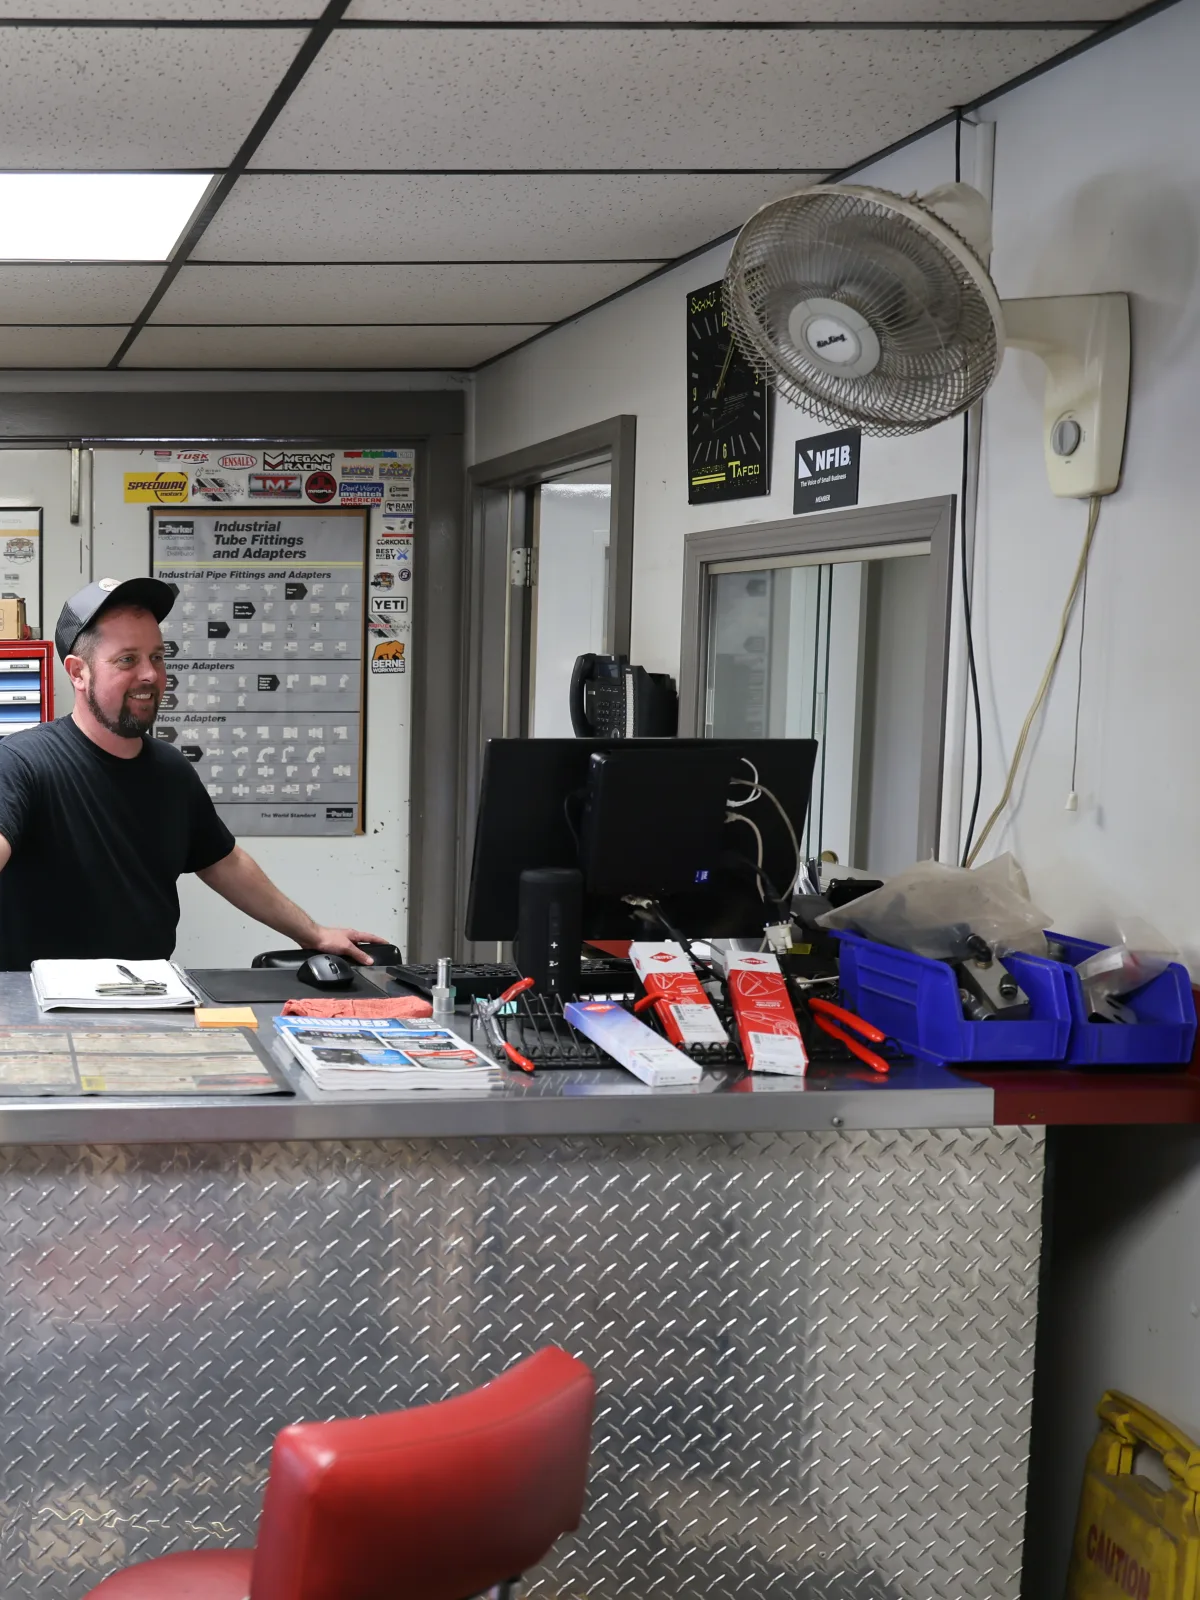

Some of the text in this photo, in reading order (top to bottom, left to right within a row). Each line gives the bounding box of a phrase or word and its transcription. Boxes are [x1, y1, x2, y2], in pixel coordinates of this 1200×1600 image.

[692, 387, 697, 401] 9
[722, 443, 728, 459] 6
[221, 457, 254, 467] JENSALES
[284, 453, 332, 463] MEGAN
[815, 444, 851, 471] NFIB
[284, 463, 332, 471] RACING
[807, 479, 817, 487] Voice
[831, 473, 847, 482] Business
[127, 481, 187, 491] SPEEDWAY
[815, 493, 831, 503] MEMBER
[165, 525, 194, 534] Parker
[214, 521, 282, 532] Industrial
[214, 534, 304, 548] Tube Fittings
[212, 548, 307, 561] and Adapters
[158, 570, 332, 581] Industrial Pipe Fittings and Adapters
[374, 600, 405, 610] YETI
[165, 662, 235, 672] lange Adapters
[372, 659, 405, 668] BERNE
[157, 714, 227, 724] Hose Adapters
[1086, 1523, 1151, 1600] CAUTION
